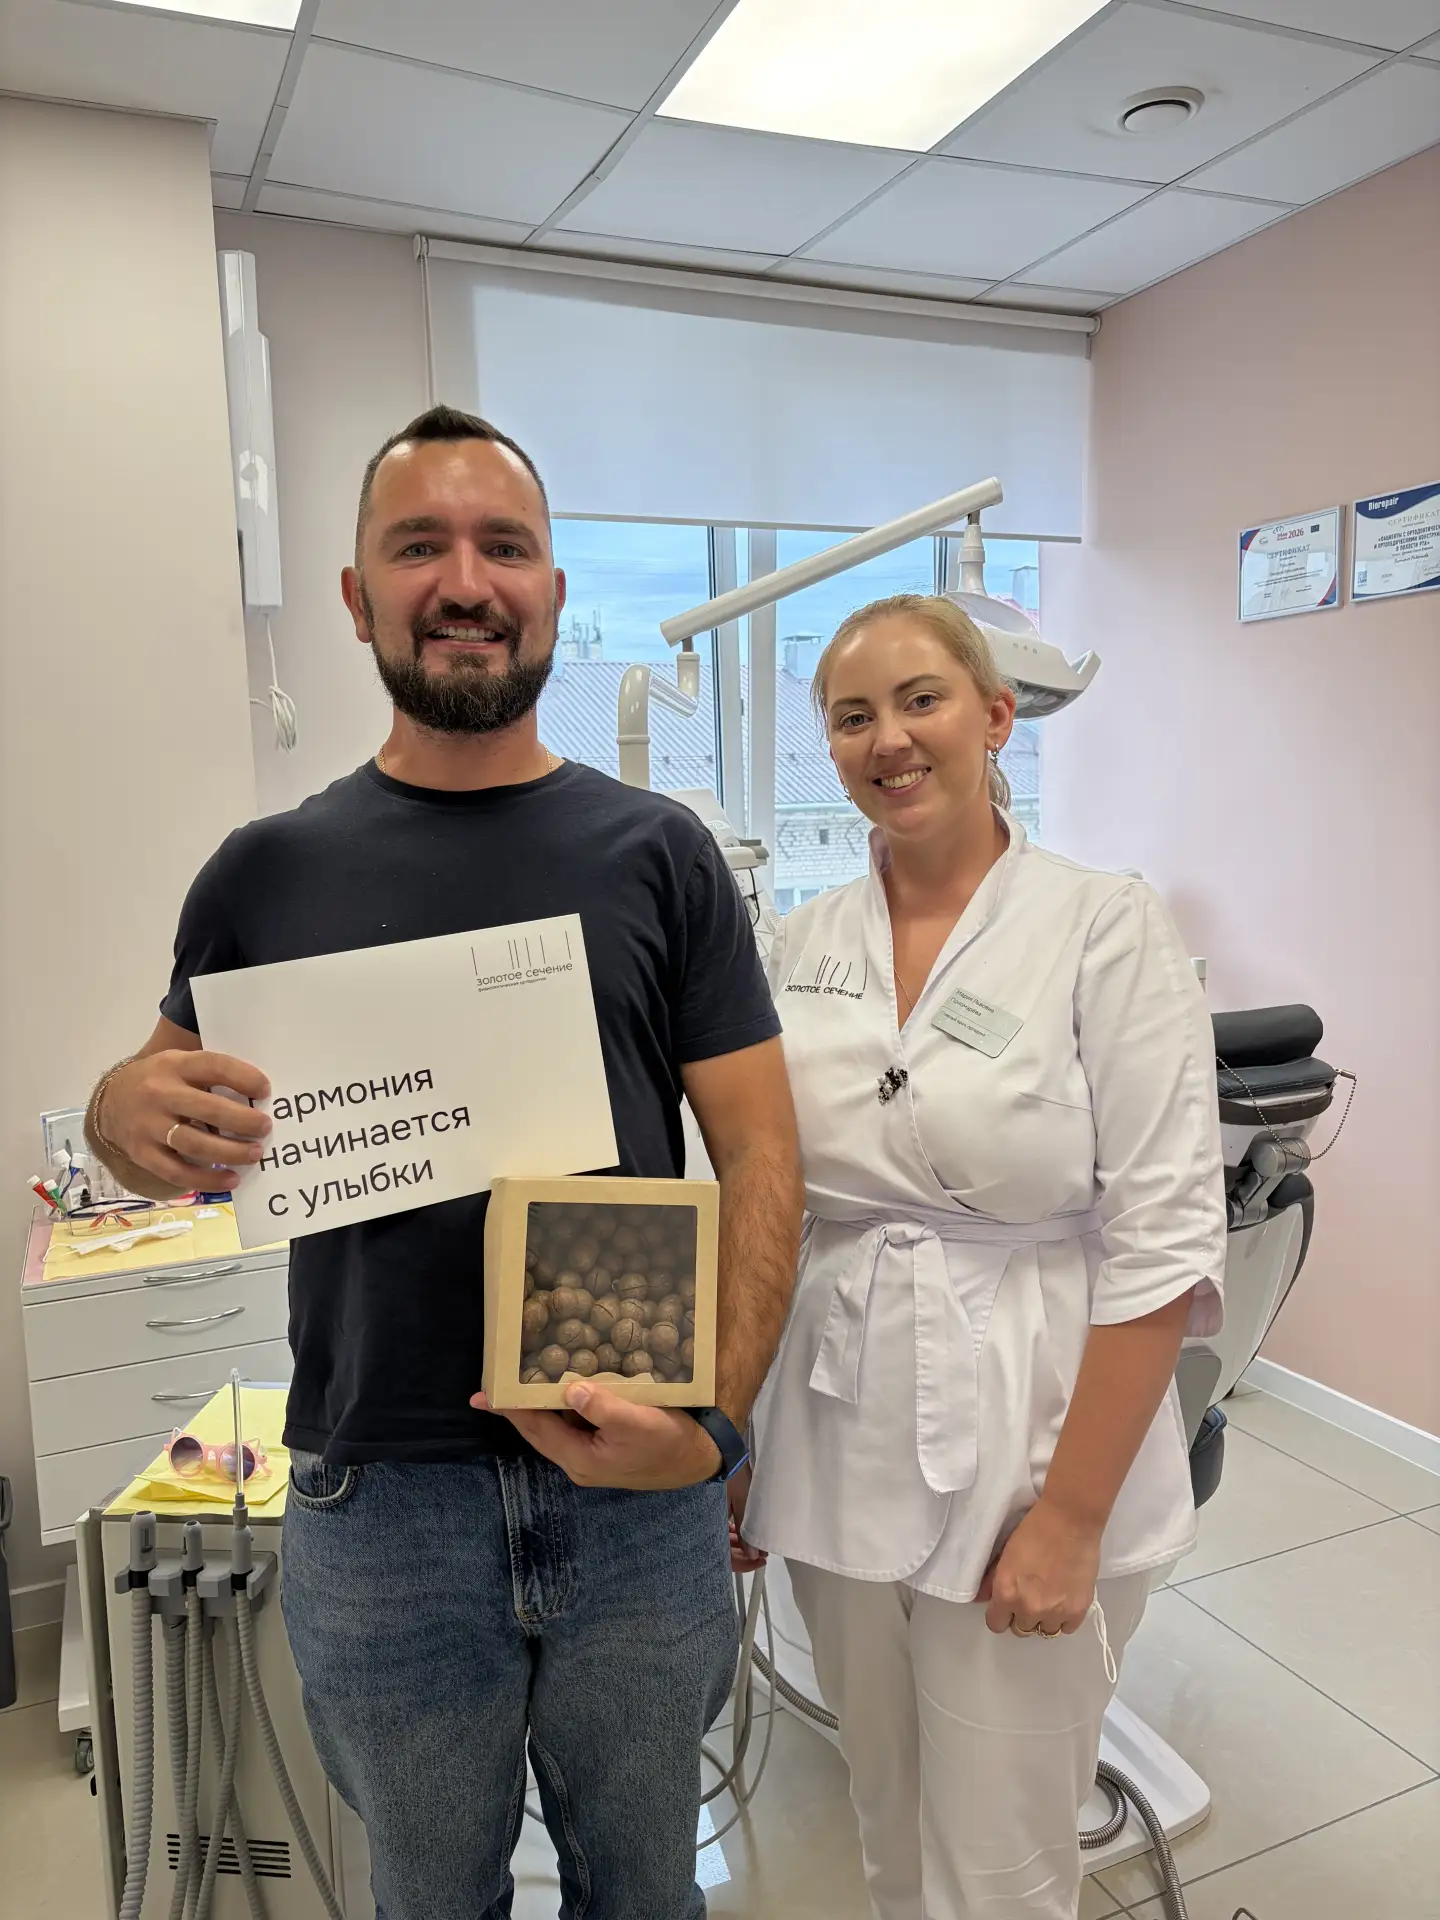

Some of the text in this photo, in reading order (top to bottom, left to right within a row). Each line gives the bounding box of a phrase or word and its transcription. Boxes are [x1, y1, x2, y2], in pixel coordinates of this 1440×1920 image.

[1368, 497, 1399, 511] Biorepair
[1288, 528, 1304, 539] 2026
[1267, 544, 1311, 559] СЕРТИФИКАТ
[476, 962, 573, 986] золотое сечение
[785, 985, 864, 1000] ЗОЛОТОЕ СЕЧЕНИЕ
[259, 1106, 471, 1172] начинается
[268, 1159, 434, 1219] с улыбки
